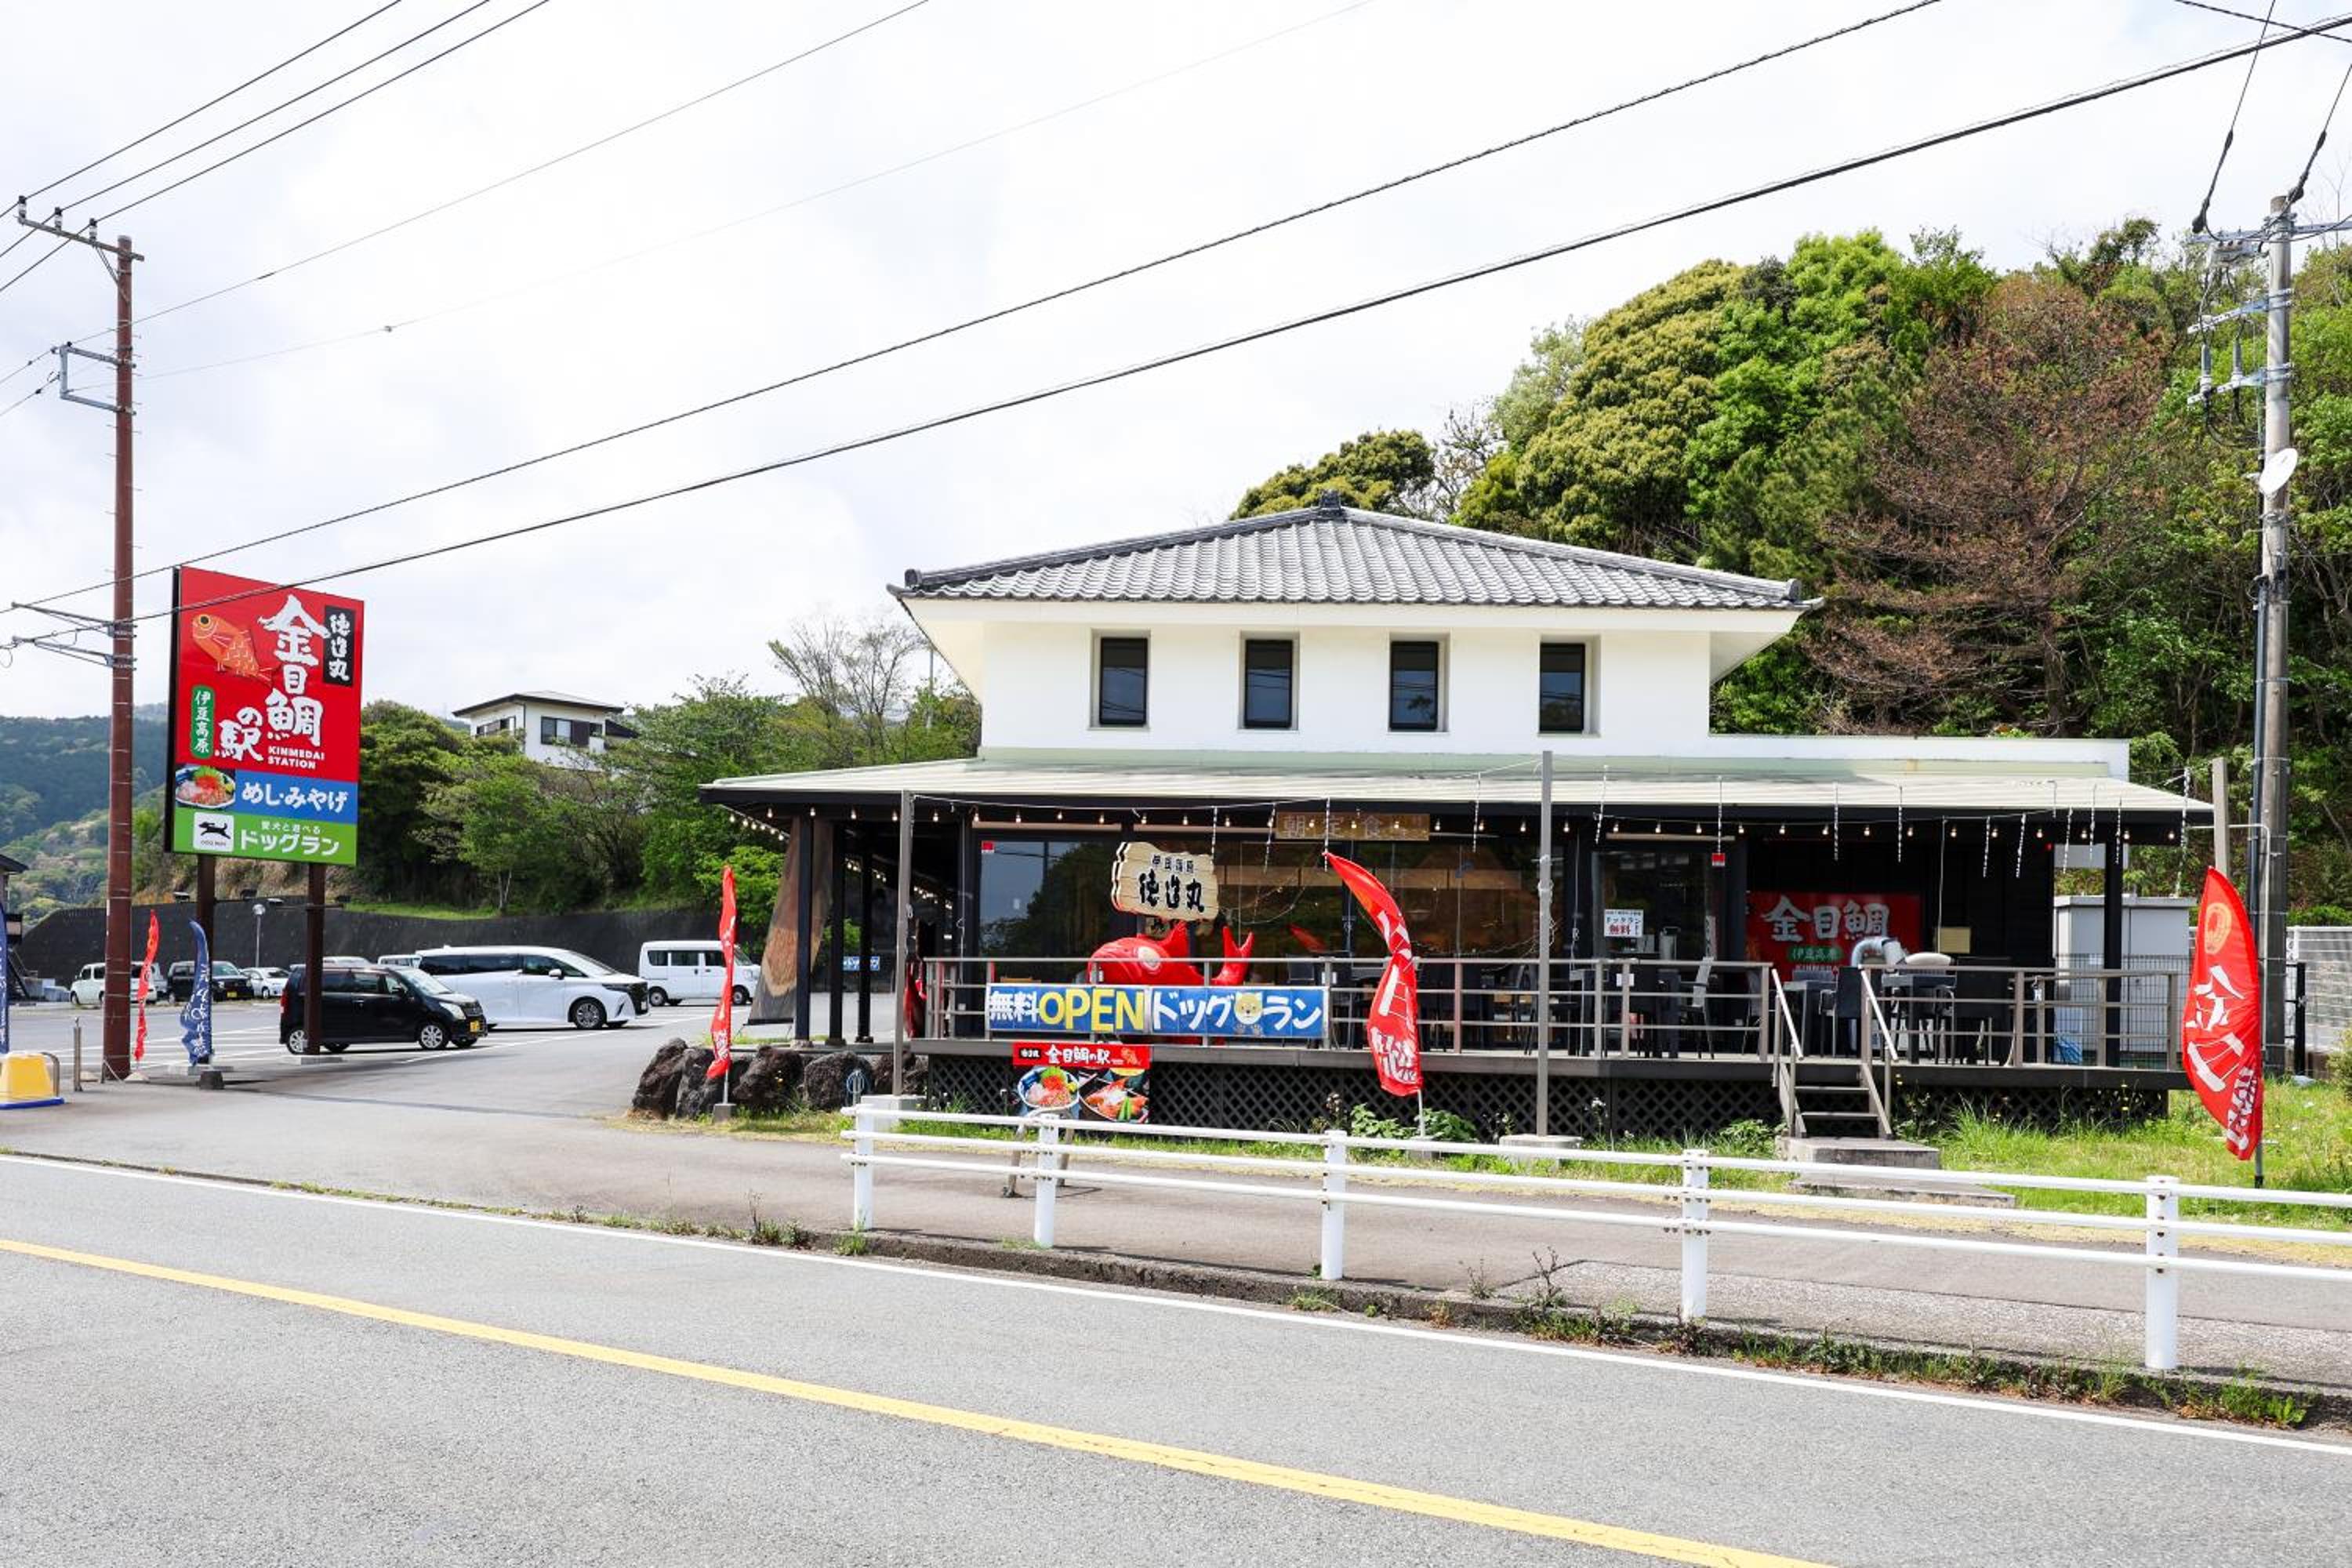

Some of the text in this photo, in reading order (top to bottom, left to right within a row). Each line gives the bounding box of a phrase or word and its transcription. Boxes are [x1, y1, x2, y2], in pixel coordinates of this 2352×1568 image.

[257, 593, 331, 747] 金目鯛
[194, 689, 212, 753] 伊豆高原
[267, 745, 325, 761] KINMEDAI
[267, 755, 317, 770] STATION
[241, 829, 340, 857] ドッグラン
[1760, 895, 1889, 942] 金目鯛
